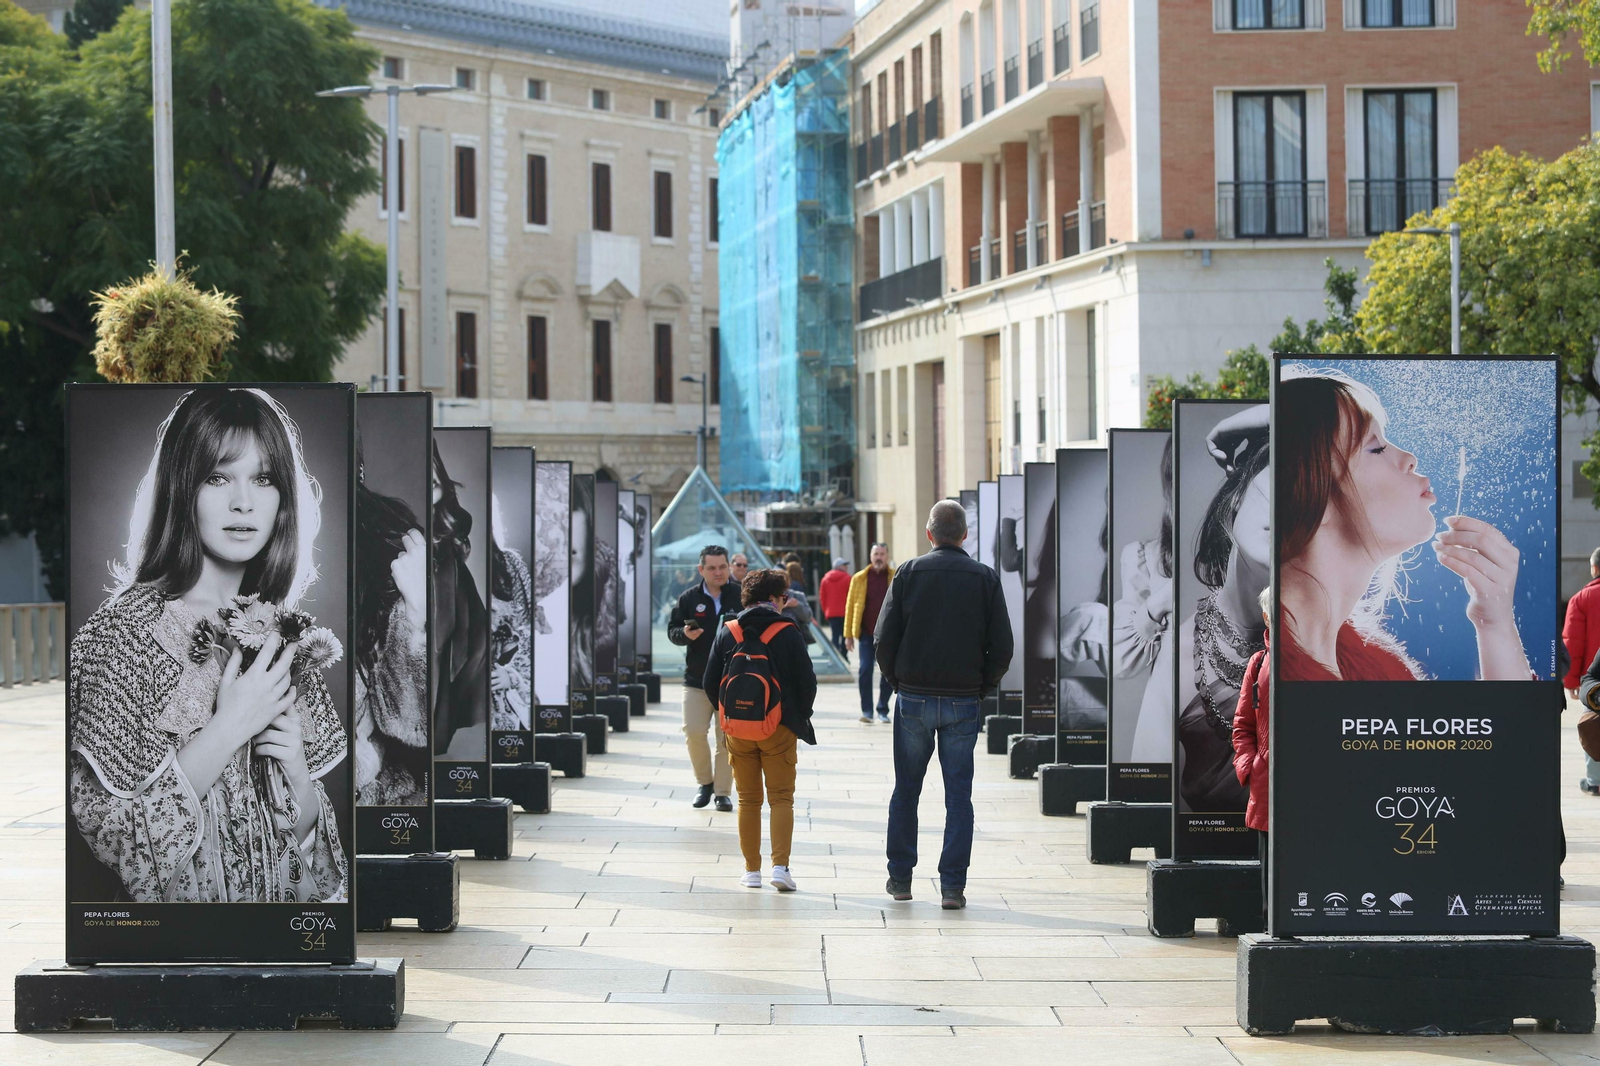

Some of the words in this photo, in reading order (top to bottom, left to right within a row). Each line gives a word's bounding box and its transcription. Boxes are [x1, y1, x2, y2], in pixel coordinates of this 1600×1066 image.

[1342, 718, 1398, 734] PEPA
[1406, 718, 1492, 734] FLORES
[498, 738, 524, 746] GOYA
[1342, 740, 1379, 750] GOYA
[1384, 740, 1401, 750] DE
[1406, 740, 1456, 750] HONOR
[1460, 740, 1492, 750] 2020
[504, 746, 519, 757] 34
[449, 770, 479, 779] GOYA
[456, 780, 472, 792] 34
[1376, 796, 1456, 818] GOYA
[382, 818, 418, 828] GOYA
[390, 830, 410, 844] 34
[1394, 823, 1438, 854] 34
[290, 917, 336, 930] GOYA
[300, 932, 326, 950] 34
